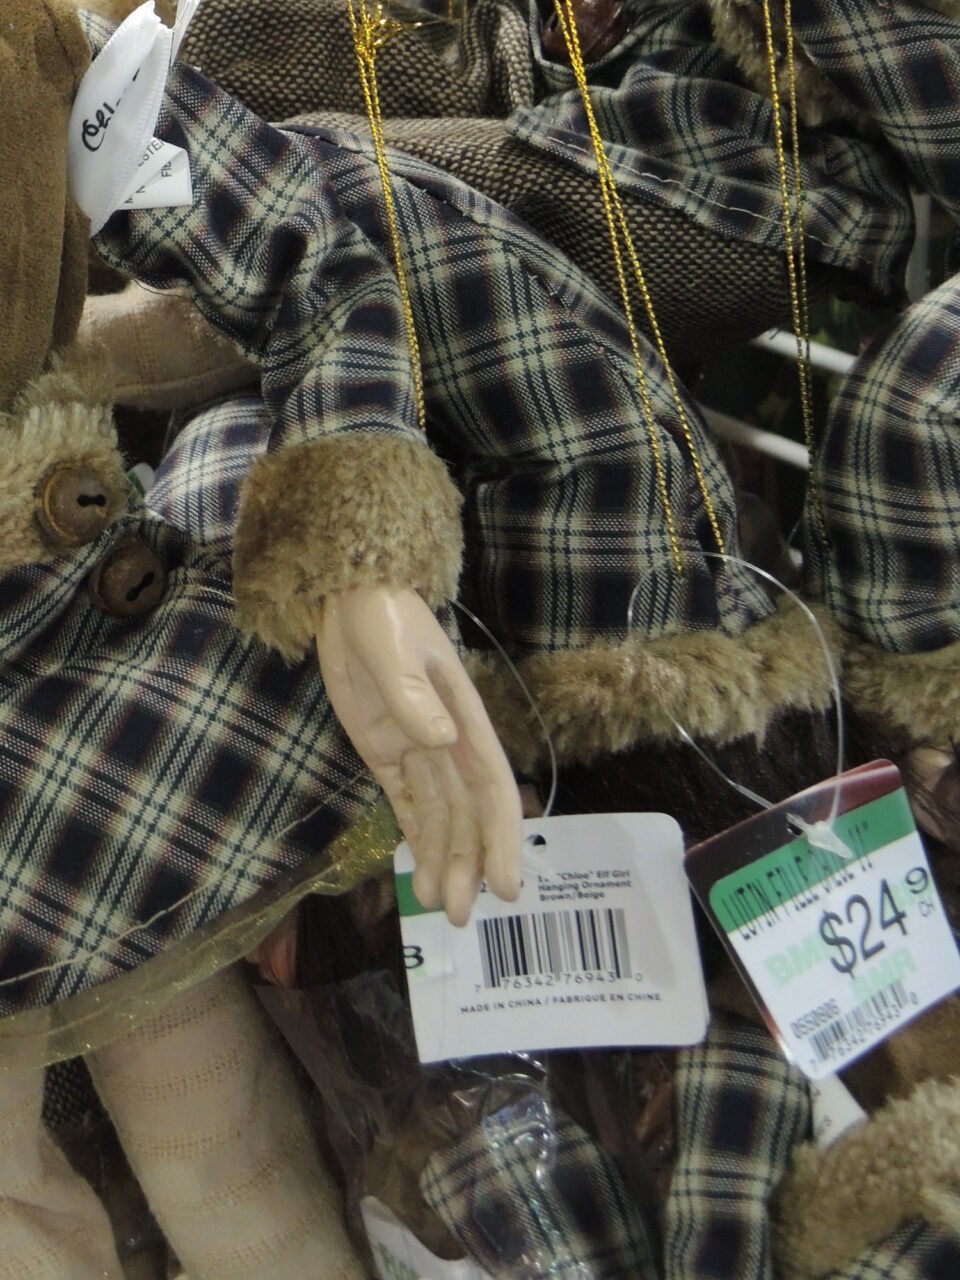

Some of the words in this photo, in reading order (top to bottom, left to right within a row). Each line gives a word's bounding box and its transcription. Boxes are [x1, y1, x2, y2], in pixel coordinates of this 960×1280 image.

[538, 882, 579, 891] Hanging
[581, 880, 632, 889] Ornament
[460, 1003, 489, 1014] MADE
[493, 1002, 505, 1010] IN
[508, 997, 541, 1008] CHINA
[552, 993, 606, 1004] FABRIQUE
[610, 993, 625, 1002] EN
[627, 992, 661, 1001] CHINE
